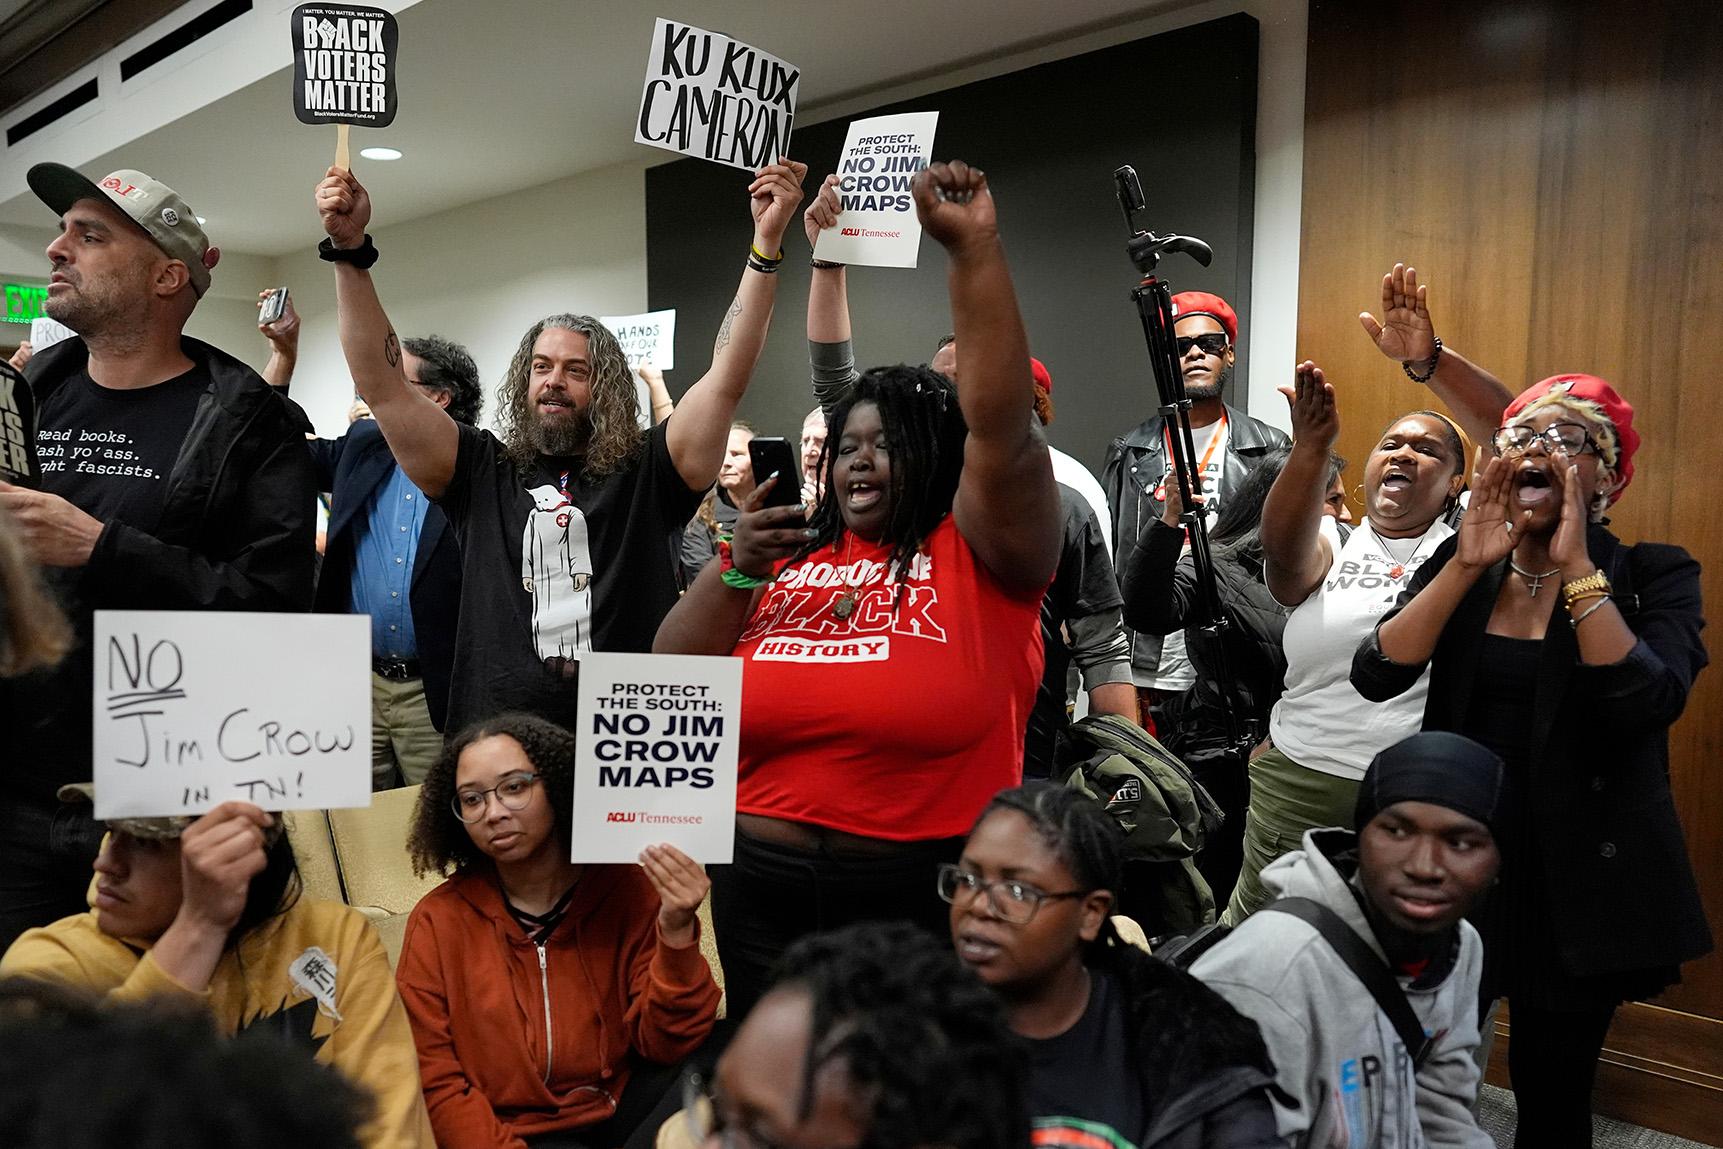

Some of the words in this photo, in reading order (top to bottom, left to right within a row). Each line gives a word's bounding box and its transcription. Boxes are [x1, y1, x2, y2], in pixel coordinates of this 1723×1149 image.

[303, 16, 385, 52] BACK
[304, 50, 386, 83] VOTERS
[662, 24, 711, 79] KU
[718, 42, 800, 113] KLUX
[305, 80, 386, 112] MATTER
[640, 80, 793, 168] CAMERON
[858, 134, 915, 146] PROTECT
[849, 147, 871, 156] THE
[873, 145, 921, 155] SOUTH:
[842, 157, 876, 173] NO
[881, 156, 921, 173] JIM
[840, 176, 914, 192] CROW
[841, 195, 911, 212] MAPS
[841, 228, 860, 236] ACLU
[861, 228, 901, 238] Tennessee
[618, 324, 659, 340] HANDS
[626, 351, 652, 365] OTE
[37, 429, 72, 441] Read
[79, 430, 133, 444] books.
[35, 445, 65, 457] ash
[40, 461, 66, 474] ght
[76, 461, 161, 479] fascists.
[739, 583, 947, 643] BLACK
[759, 641, 885, 657] HISTORY
[109, 633, 183, 692] NO
[612, 683, 709, 697] PROTECT
[597, 698, 638, 709] THE
[645, 699, 722, 711] SOUTH:
[593, 714, 650, 735] NO
[662, 715, 723, 737] JIM
[594, 740, 720, 762] CROW
[599, 766, 714, 789] MAPS
[183, 787, 209, 806] IN
[235, 771, 303, 801] TN!
[607, 812, 636, 823] ACLU
[638, 812, 703, 824] Tennessee
